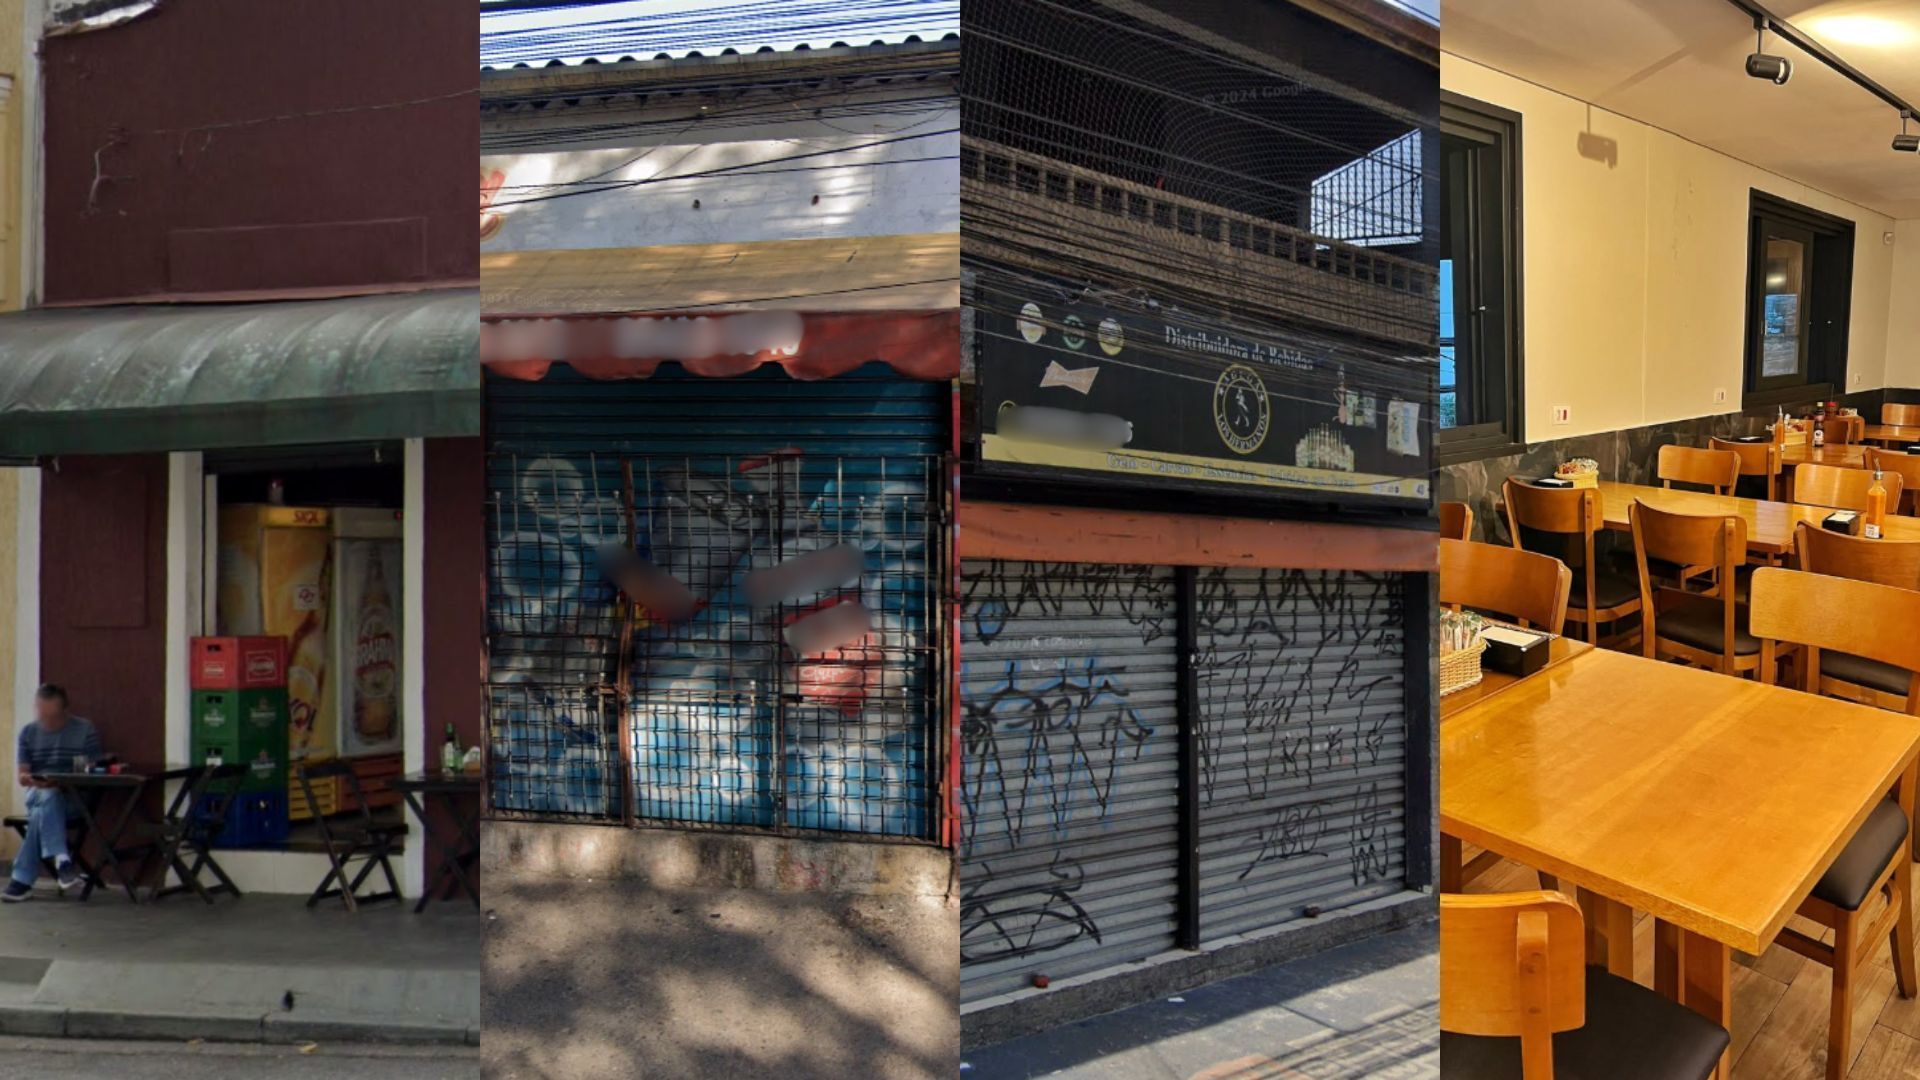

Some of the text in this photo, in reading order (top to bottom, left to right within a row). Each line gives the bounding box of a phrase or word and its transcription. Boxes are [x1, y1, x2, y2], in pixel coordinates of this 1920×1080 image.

[1164, 325, 1314, 371] Distribuidora de Bebidas
